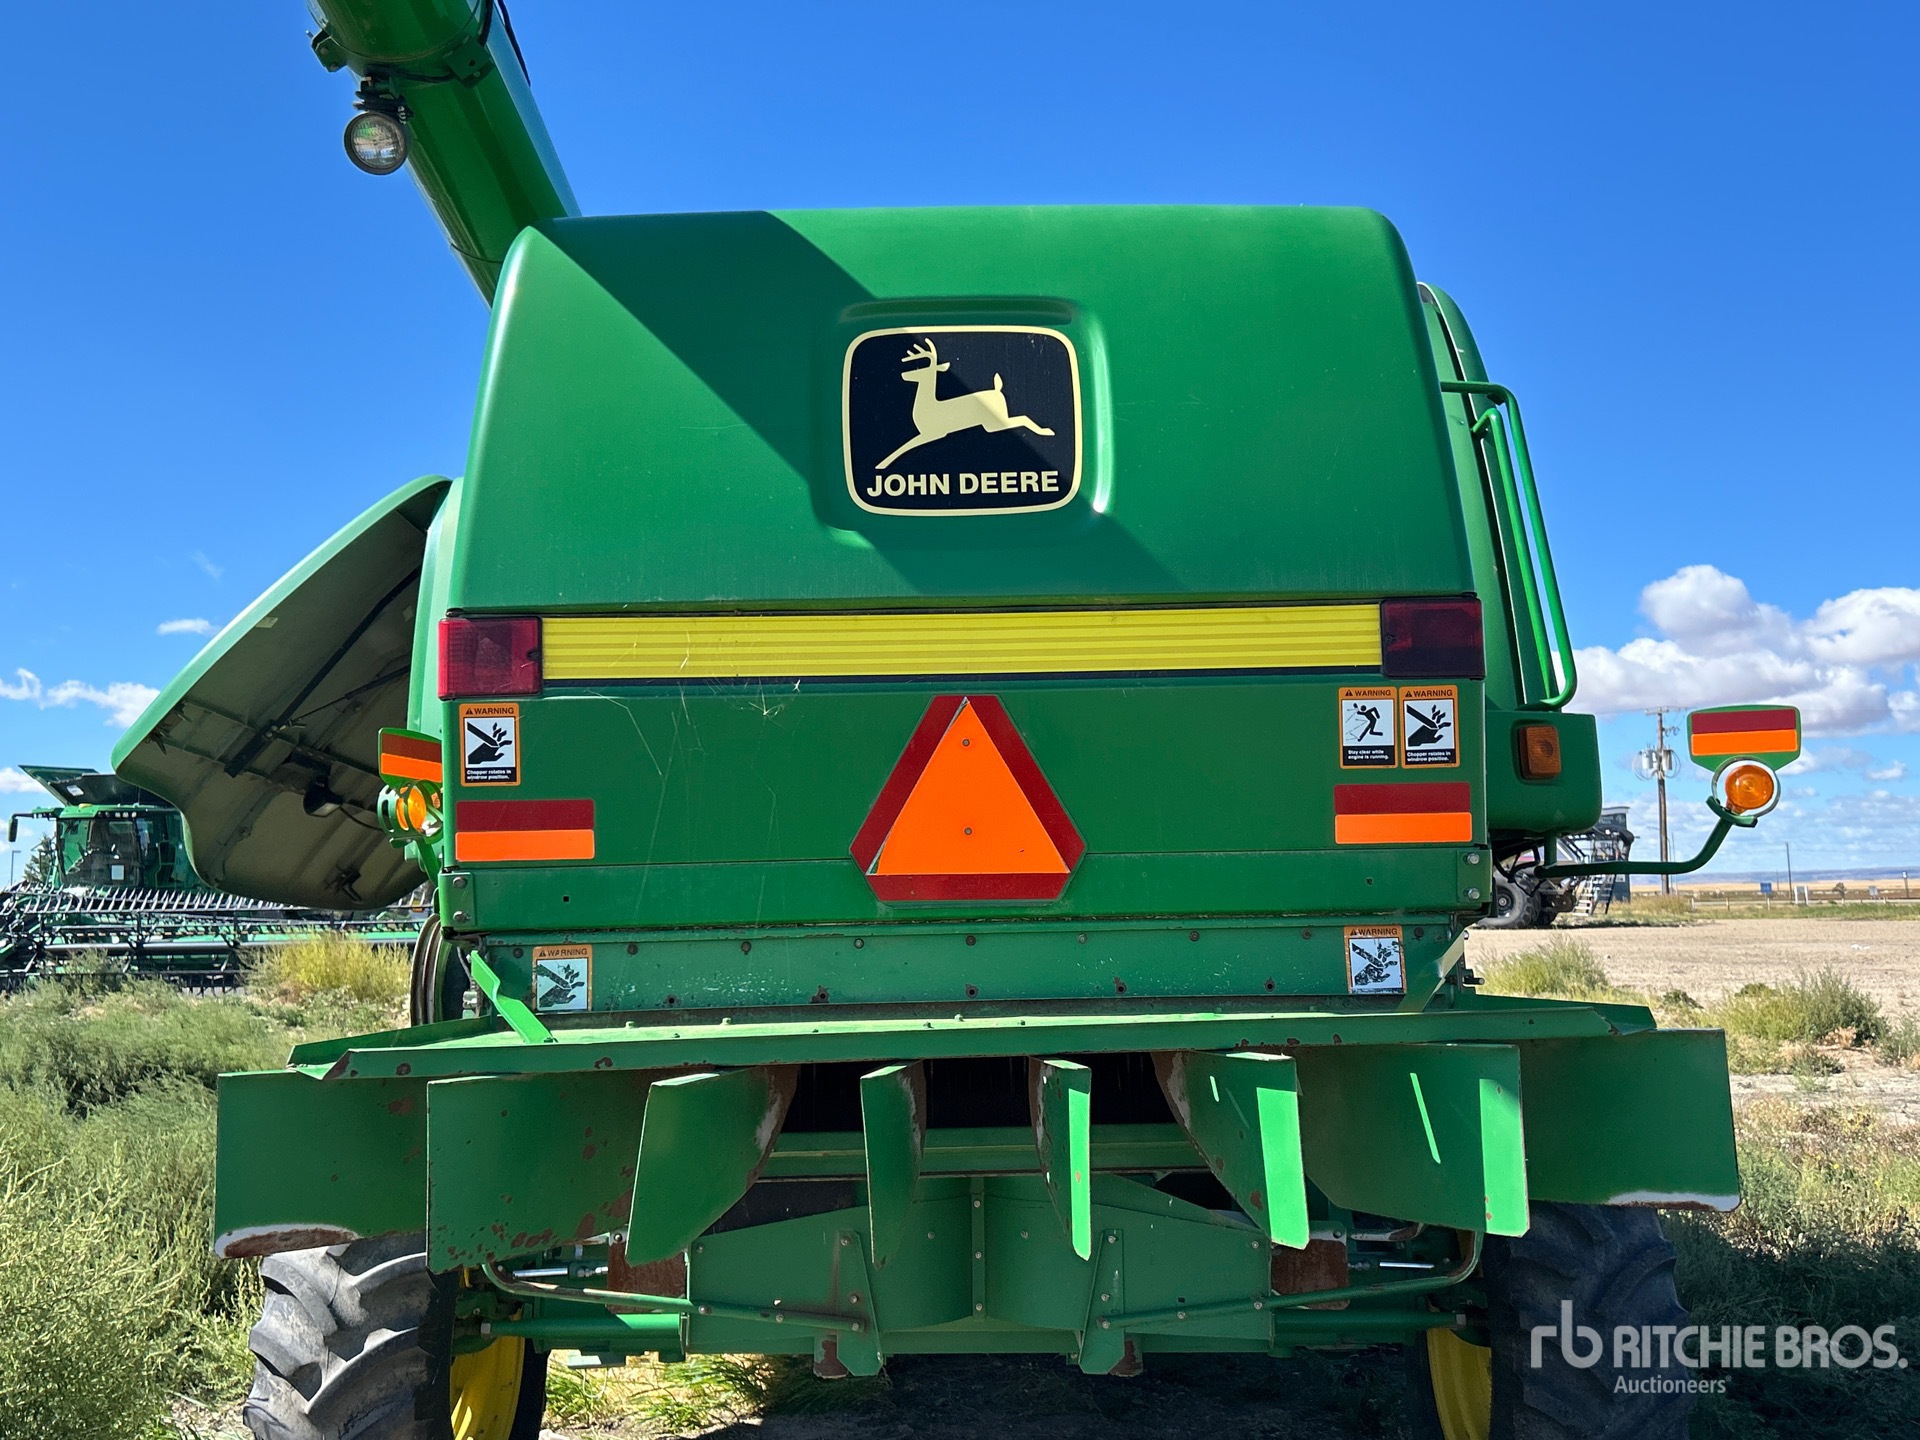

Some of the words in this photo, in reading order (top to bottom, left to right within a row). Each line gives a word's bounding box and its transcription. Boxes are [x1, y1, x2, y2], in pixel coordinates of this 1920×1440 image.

[867, 473, 950, 497] JOHN
[959, 471, 1060, 495] DEERE
[1413, 689, 1453, 698] WARNING
[474, 707, 514, 715] WARNING
[548, 948, 588, 956] WARNING
